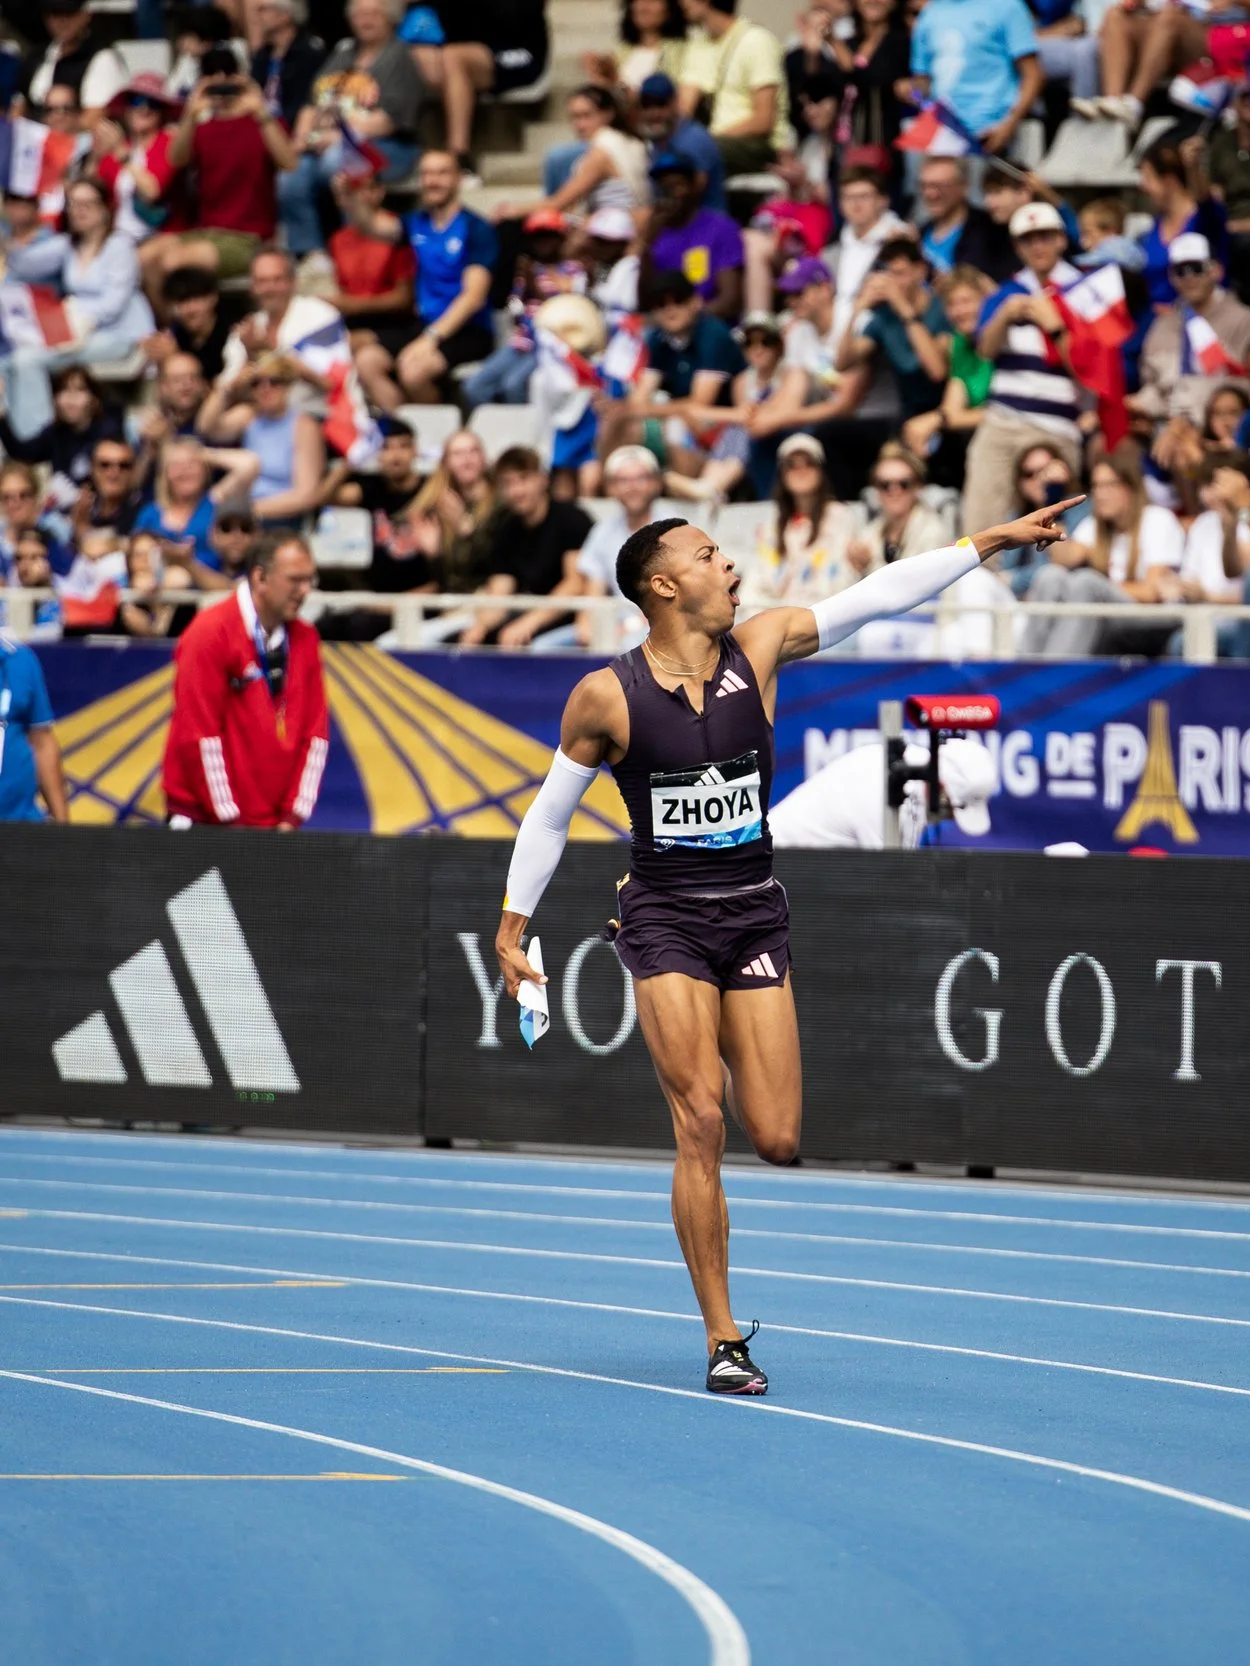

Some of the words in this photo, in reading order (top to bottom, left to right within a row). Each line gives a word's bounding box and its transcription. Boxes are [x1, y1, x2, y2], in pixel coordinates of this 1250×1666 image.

[1045, 731, 1097, 779] DE
[662, 787, 754, 825] ZHOYA
[456, 932, 642, 1056] YO
[934, 947, 1223, 1080] GOT
